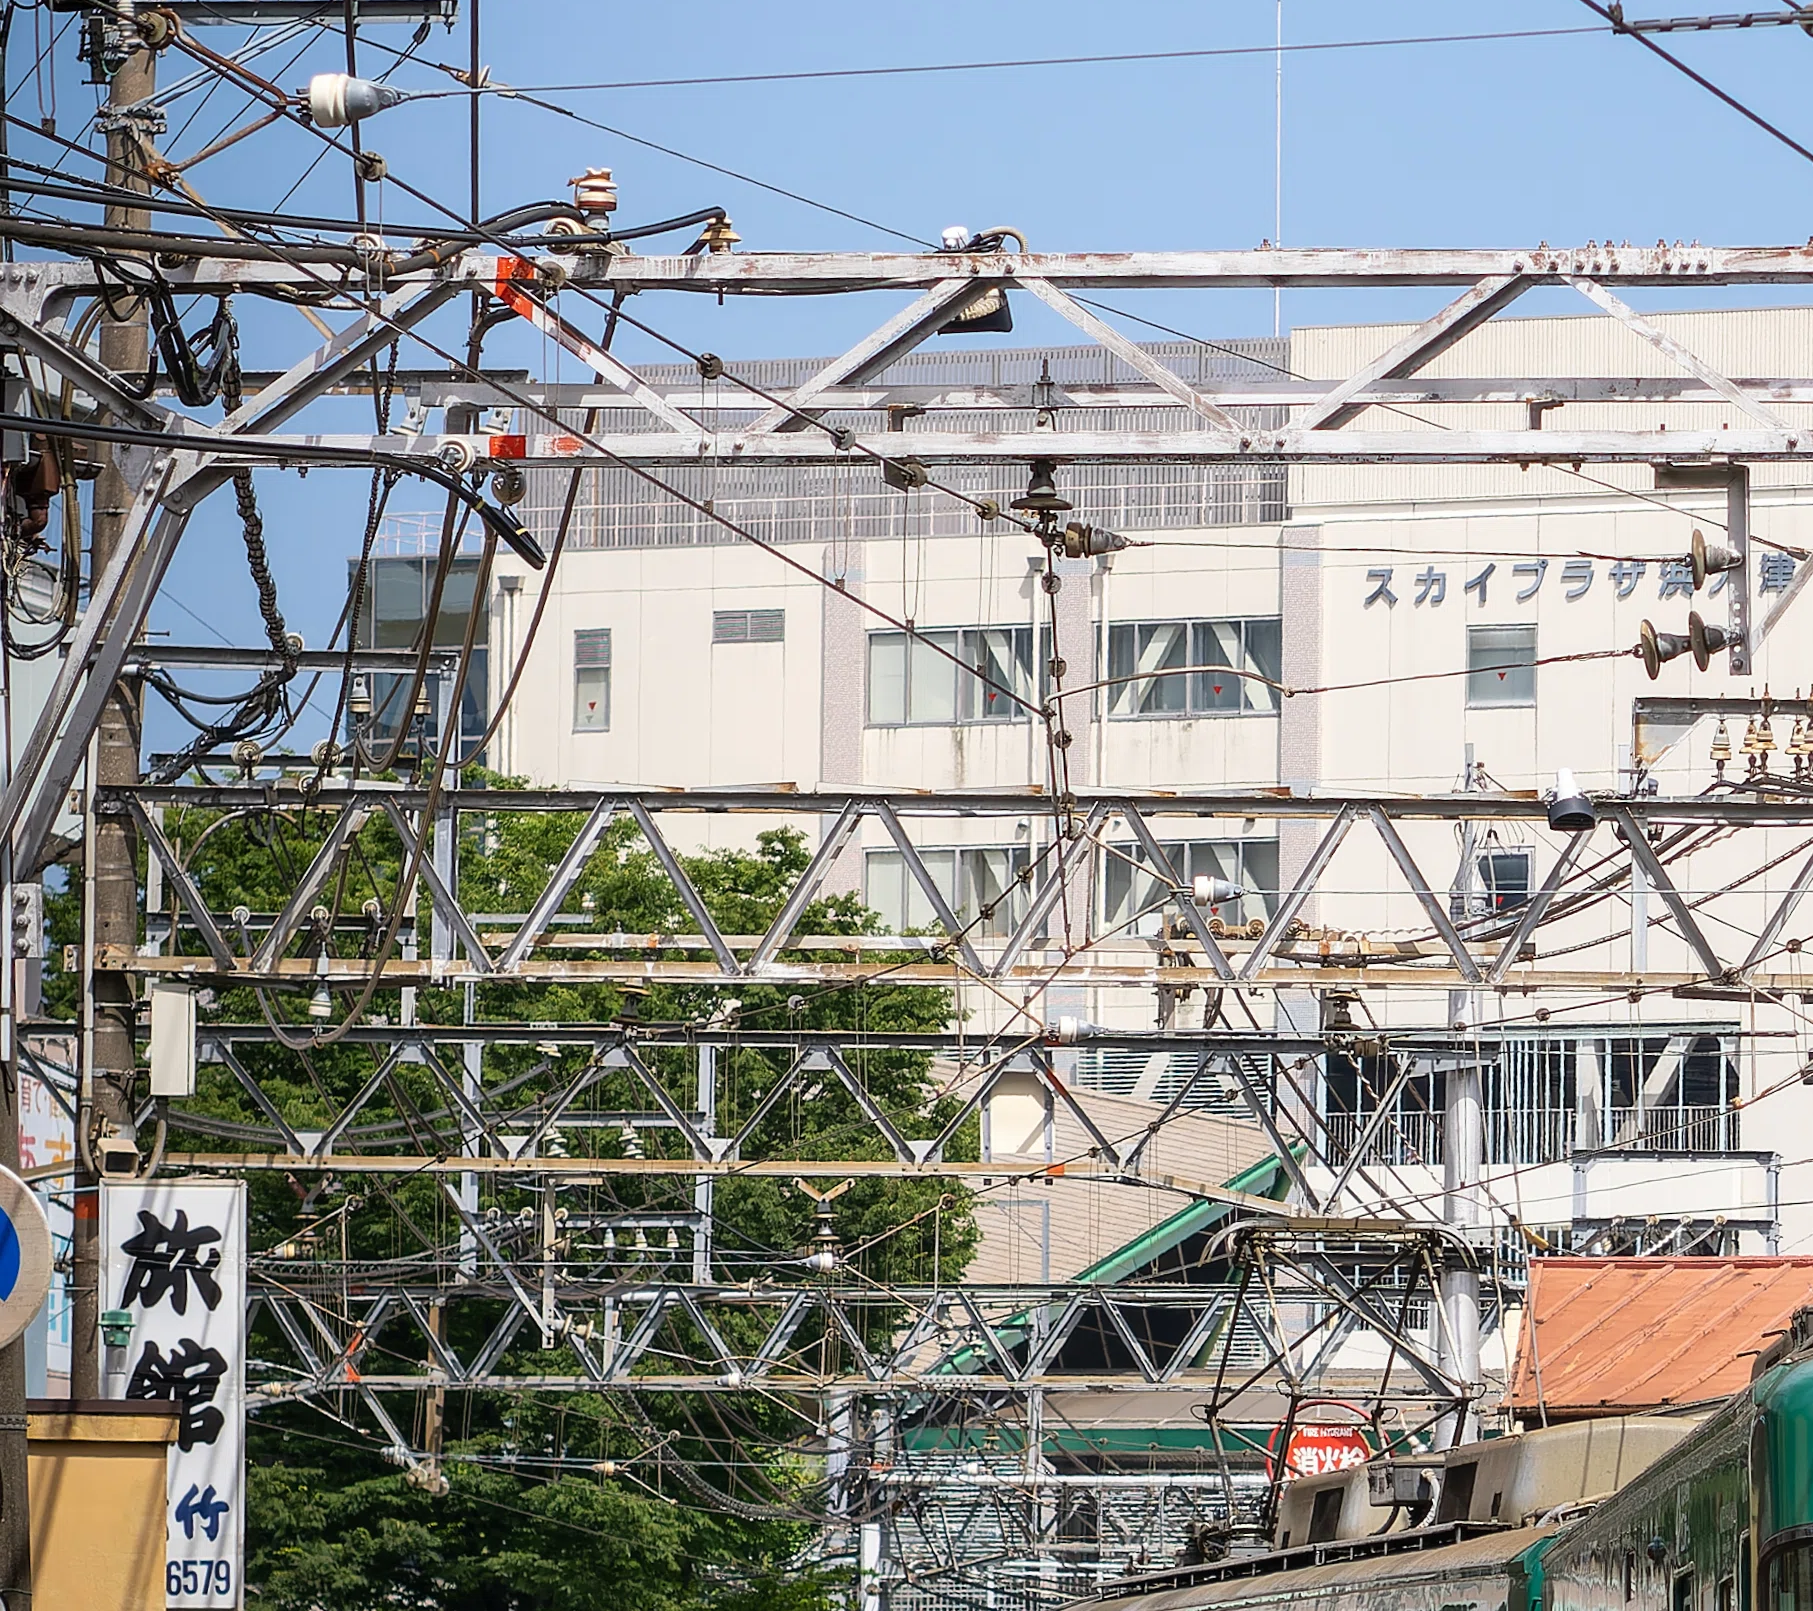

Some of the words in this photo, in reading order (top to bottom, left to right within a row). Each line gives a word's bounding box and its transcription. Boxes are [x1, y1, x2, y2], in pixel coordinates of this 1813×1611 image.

[1364, 552, 1797, 607] スカイプラザ浜津
[119, 1208, 228, 1453] 旅館
[1302, 1428, 1319, 1438] FIRE
[166, 1560, 231, 1596] 6579
